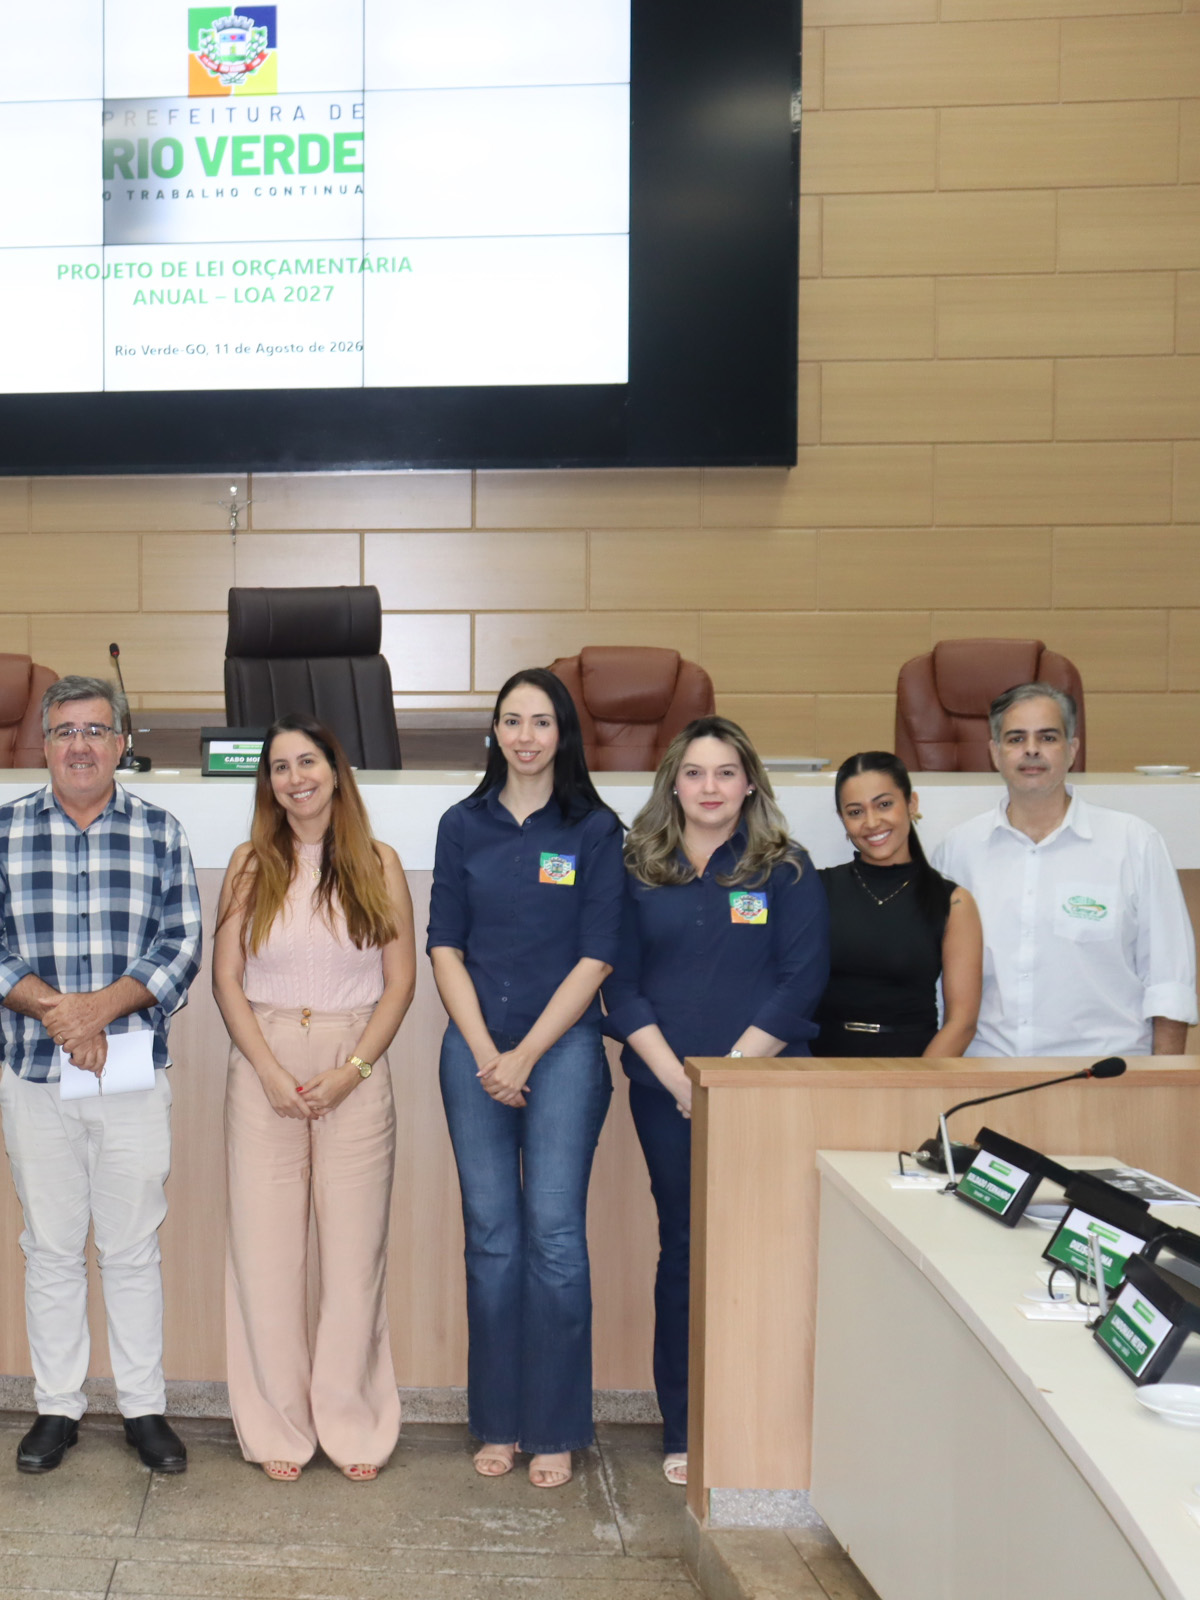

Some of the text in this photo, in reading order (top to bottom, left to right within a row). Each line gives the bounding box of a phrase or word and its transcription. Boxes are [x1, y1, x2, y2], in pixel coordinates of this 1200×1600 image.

[101, 103, 364, 127] PREFEITURA DE
[102, 131, 364, 181] RIO VERDE
[102, 184, 364, 202] O TRABALHO CONTINUA
[57, 252, 413, 280] PROJETO DE LEI ORÇAMENTÁRIA
[133, 288, 209, 306] ANUAL
[234, 286, 276, 304] LOA
[283, 284, 335, 303] 2027
[115, 340, 364, 357] Rio Verde-GO, 11 de Agosto de 2026
